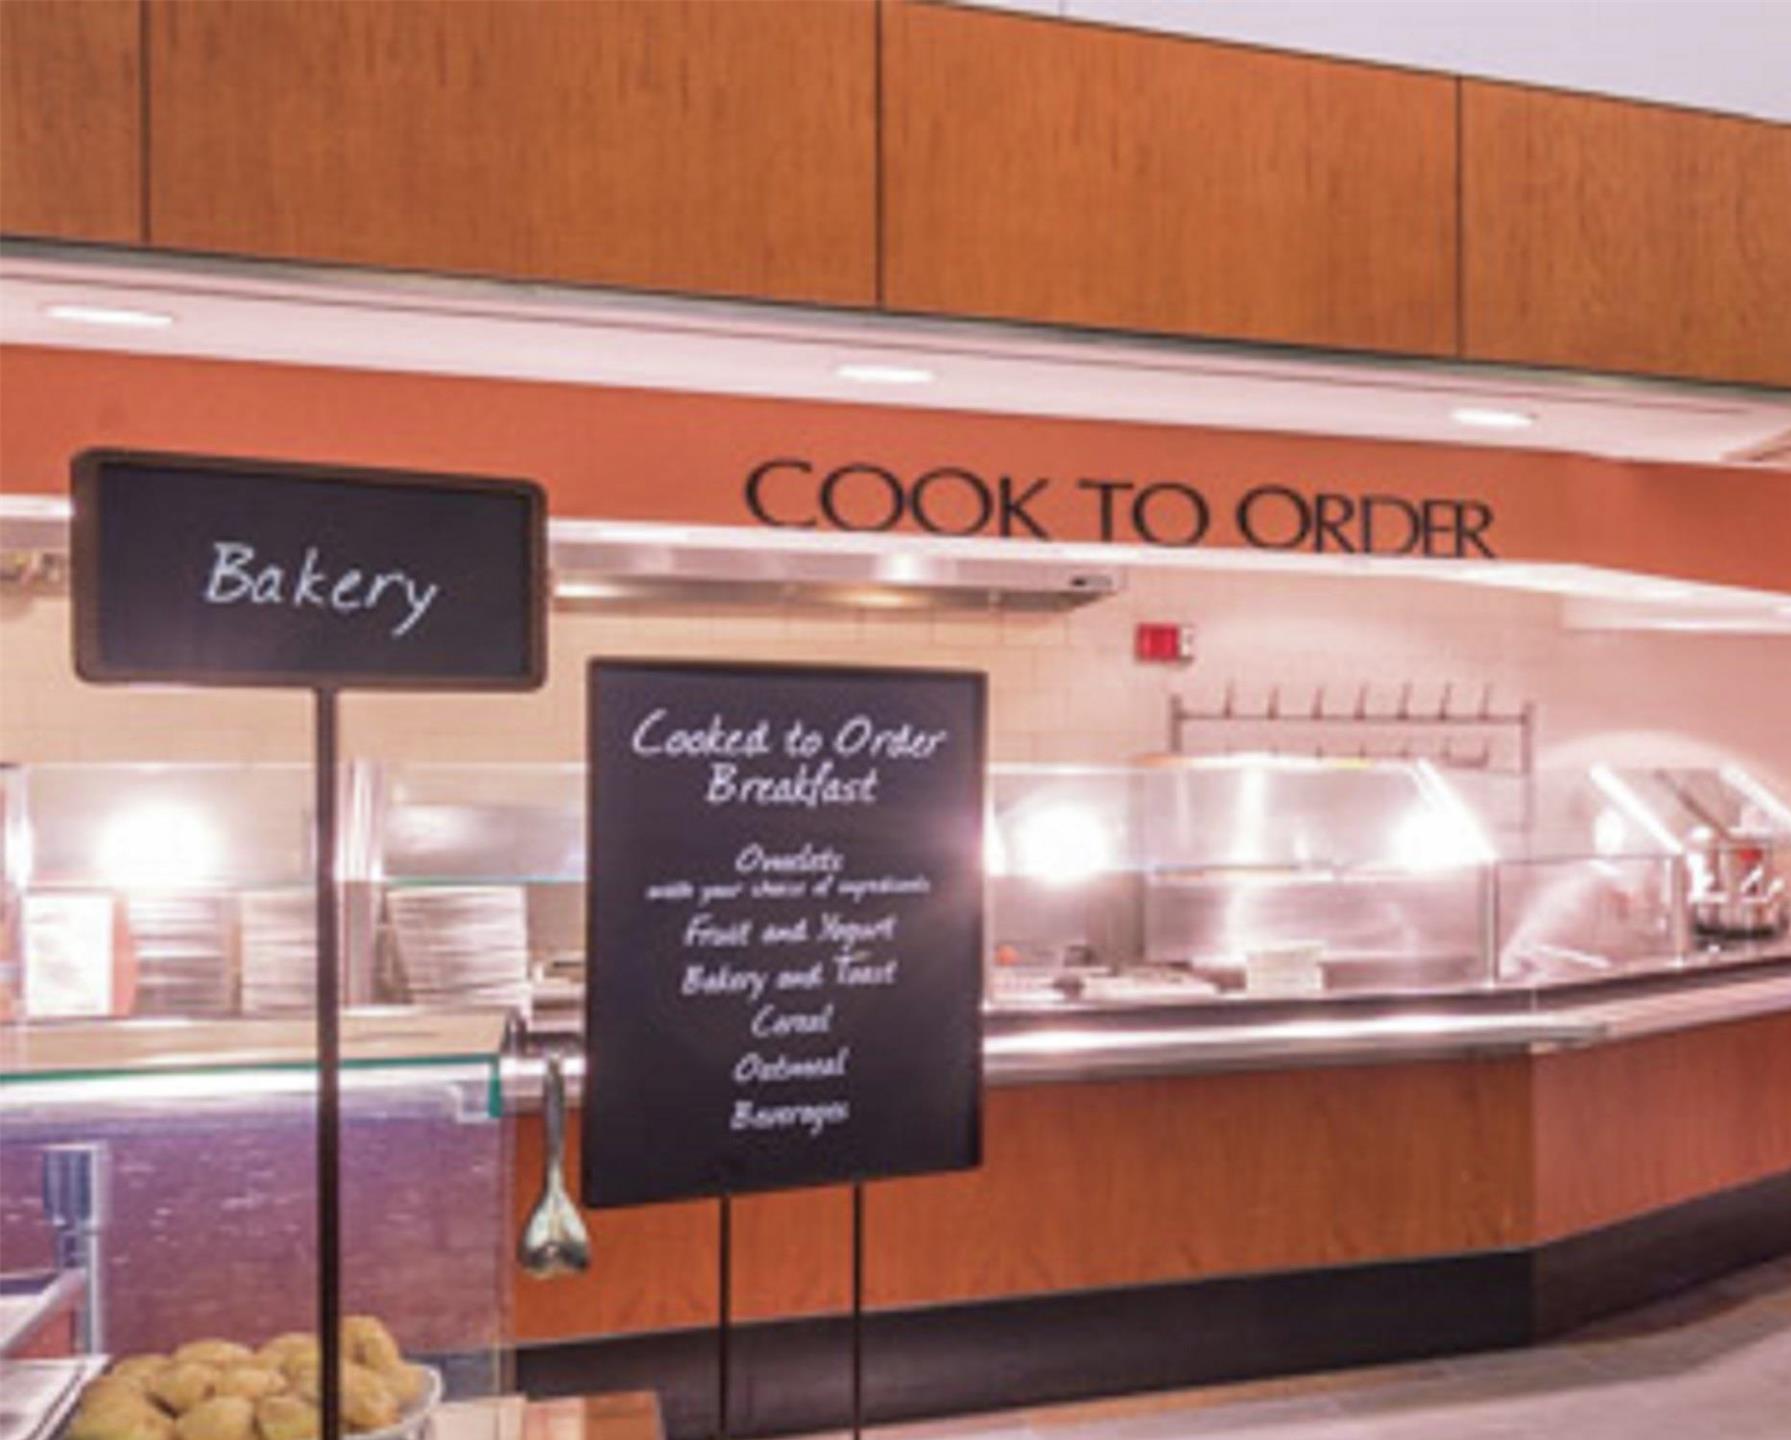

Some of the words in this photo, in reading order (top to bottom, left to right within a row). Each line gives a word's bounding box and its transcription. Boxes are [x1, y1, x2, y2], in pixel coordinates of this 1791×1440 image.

[744, 458, 1051, 541] COOK
[1078, 478, 1211, 548] TO
[1236, 484, 1498, 560] ORDER
[205, 541, 439, 638] Bakery
[632, 707, 770, 757] Cooked
[784, 719, 823, 758] to
[831, 714, 948, 759] Order
[705, 760, 879, 808] Breakfast
[734, 842, 844, 873] Omelets
[645, 880, 694, 899] with
[700, 882, 743, 907] your
[751, 879, 806, 898] choice
[811, 873, 835, 897] of
[837, 873, 931, 903] ingredients
[683, 912, 753, 947] Fruit
[761, 918, 808, 944] and
[816, 912, 898, 951] Yogurt
[680, 963, 769, 1001] Bakery
[777, 961, 824, 990] and
[831, 950, 898, 986] Toast
[750, 1003, 835, 1039] Cereal
[732, 1046, 851, 1083] Oatmeal
[729, 1100, 851, 1136] Beverages
